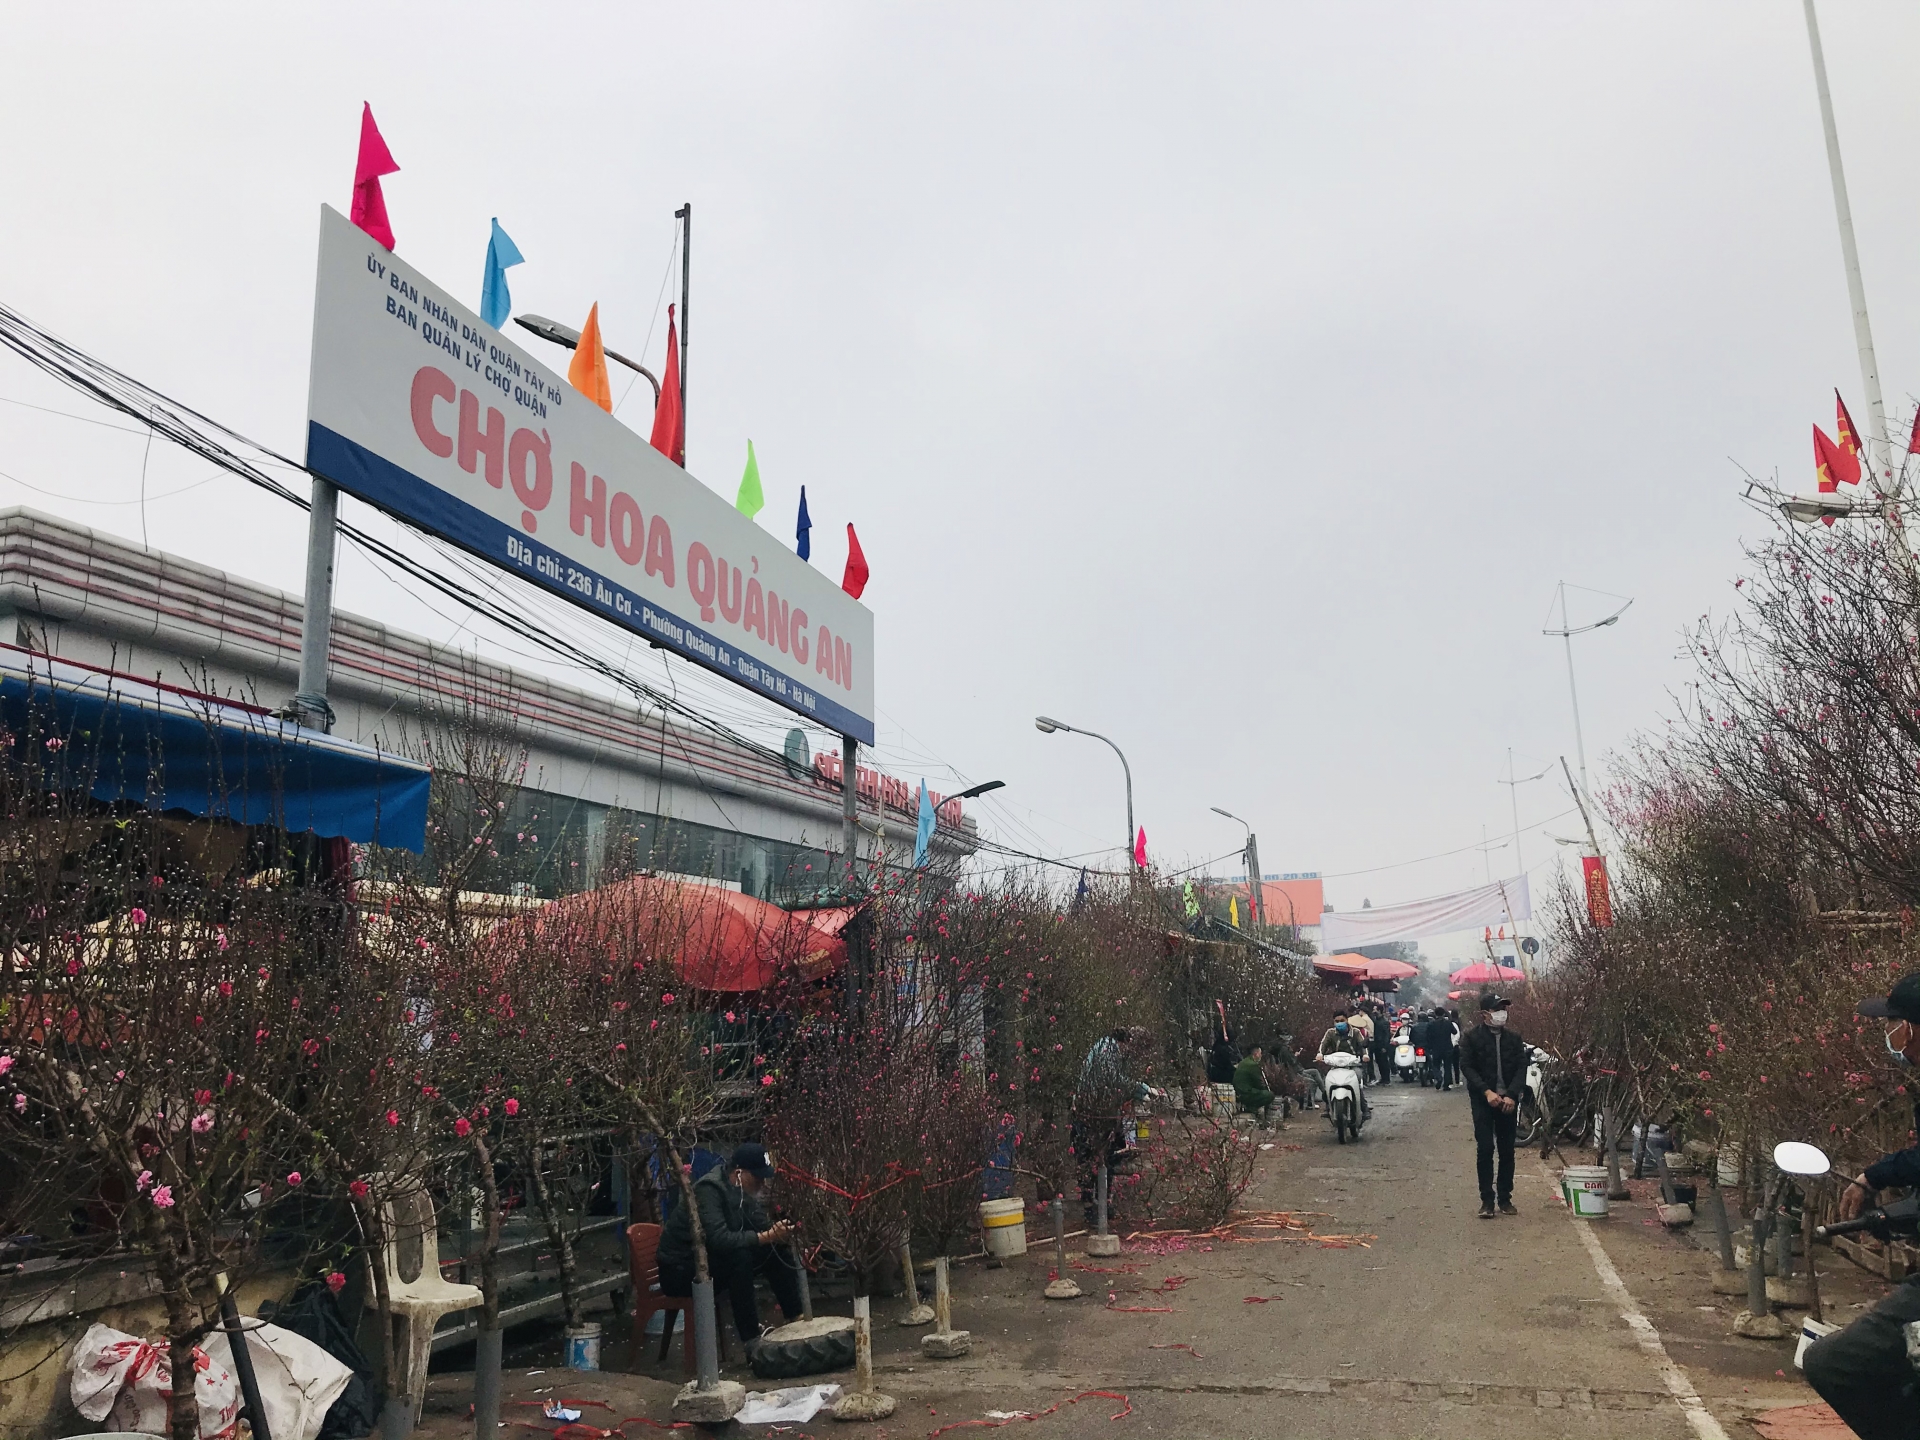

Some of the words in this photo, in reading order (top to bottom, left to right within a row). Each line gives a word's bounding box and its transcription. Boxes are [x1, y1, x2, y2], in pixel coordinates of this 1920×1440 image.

[367, 252, 386, 279] ỦY
[390, 272, 418, 304] BAN
[422, 295, 458, 332] NHÂN
[462, 323, 487, 353] DÂN
[490, 345, 521, 378] QUẬN
[524, 368, 545, 393] TÂY
[386, 294, 418, 330] BAN
[422, 330, 461, 360] QUẢN
[465, 349, 481, 373] LÝ
[485, 364, 512, 397] CHỢ
[514, 384, 547, 419] QUẬN
[410, 365, 553, 534] CHỢ
[569, 460, 676, 588] HOA
[686, 541, 809, 665] QUẢNG
[815, 624, 852, 691] AN
[507, 534, 533, 567] Địa
[536, 555, 564, 583] chỉ:
[567, 567, 593, 596] 236
[595, 578, 613, 607] Âu
[615, 592, 633, 616] Cơ
[642, 605, 683, 645] Phường
[685, 629, 716, 661] Quảng
[718, 646, 731, 666] An
[738, 656, 759, 682] Quận
[760, 668, 775, 691] Tây
[792, 685, 803, 704] Hà
[803, 691, 816, 712] Nội
